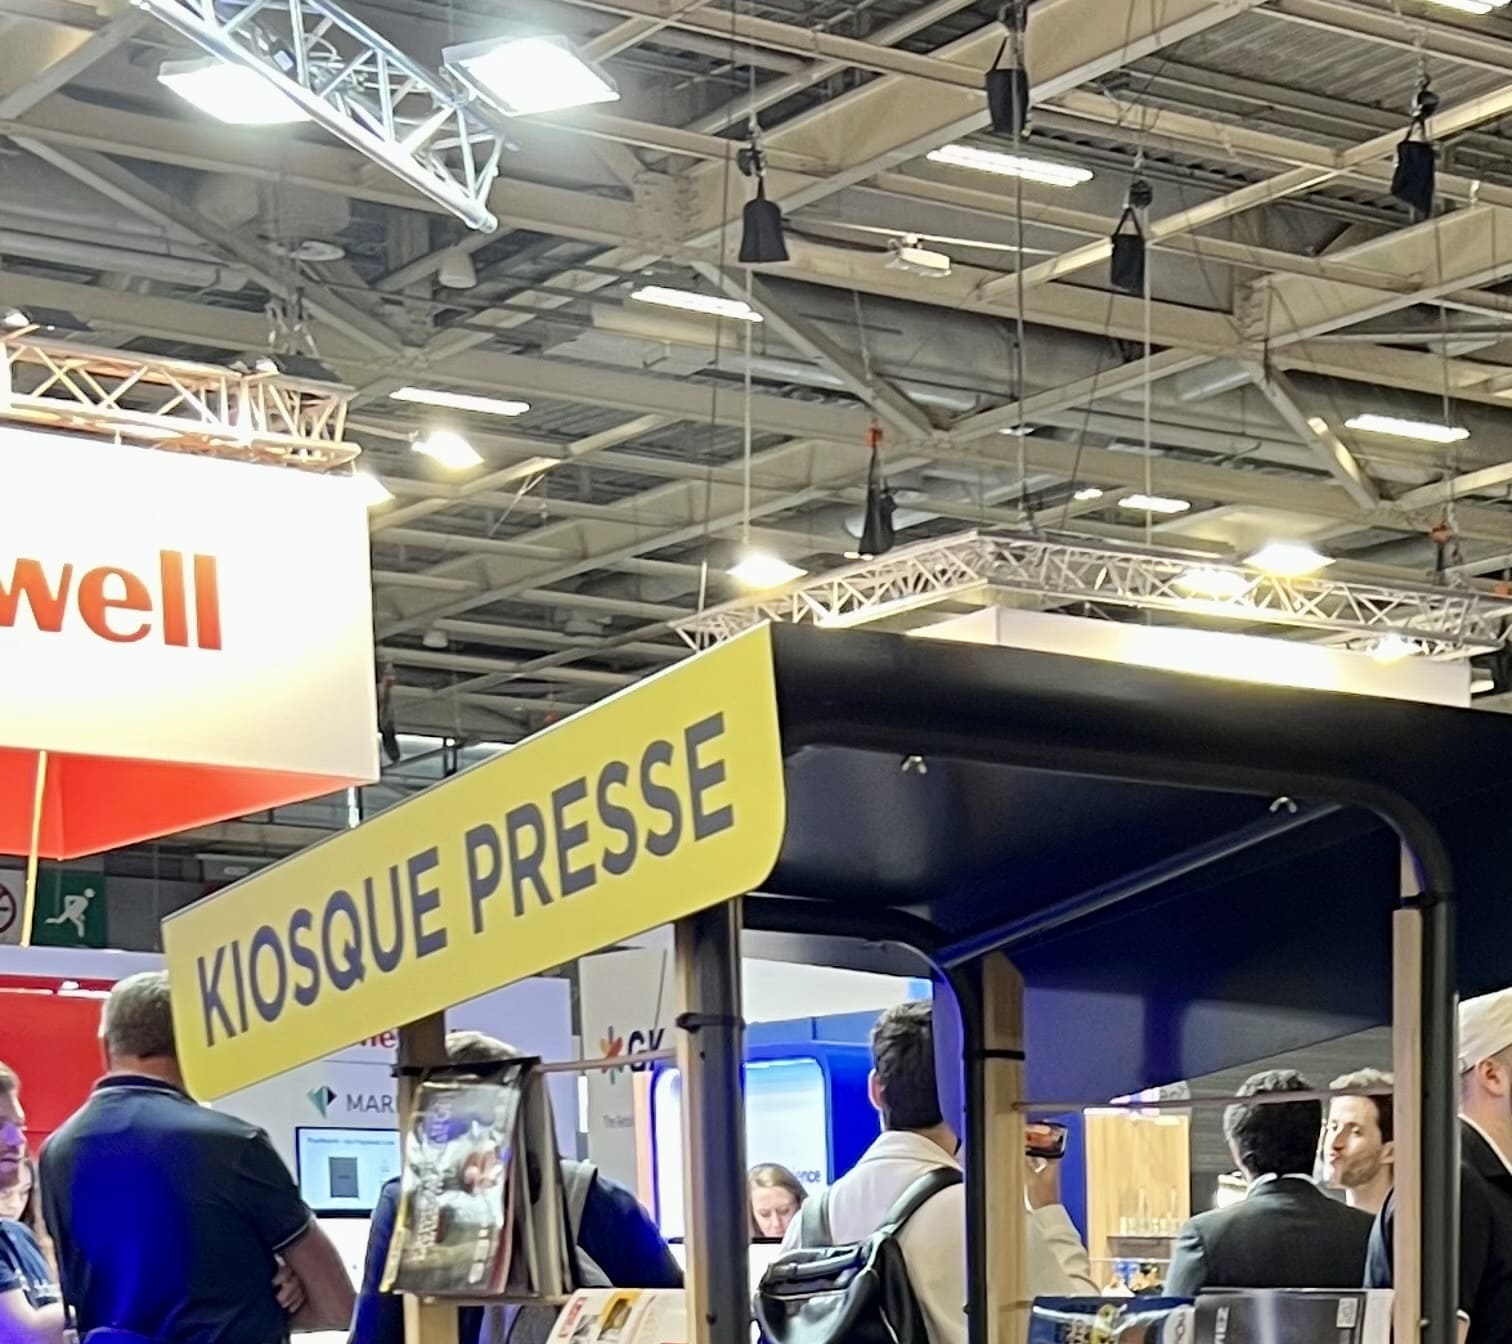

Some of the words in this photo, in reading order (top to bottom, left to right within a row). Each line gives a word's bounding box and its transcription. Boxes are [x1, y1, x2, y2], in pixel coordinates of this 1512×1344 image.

[0, 549, 222, 651] well
[195, 848, 449, 1048] KIOSQUE
[464, 711, 735, 935] PRESSE
[346, 1094, 395, 1113] MAR
